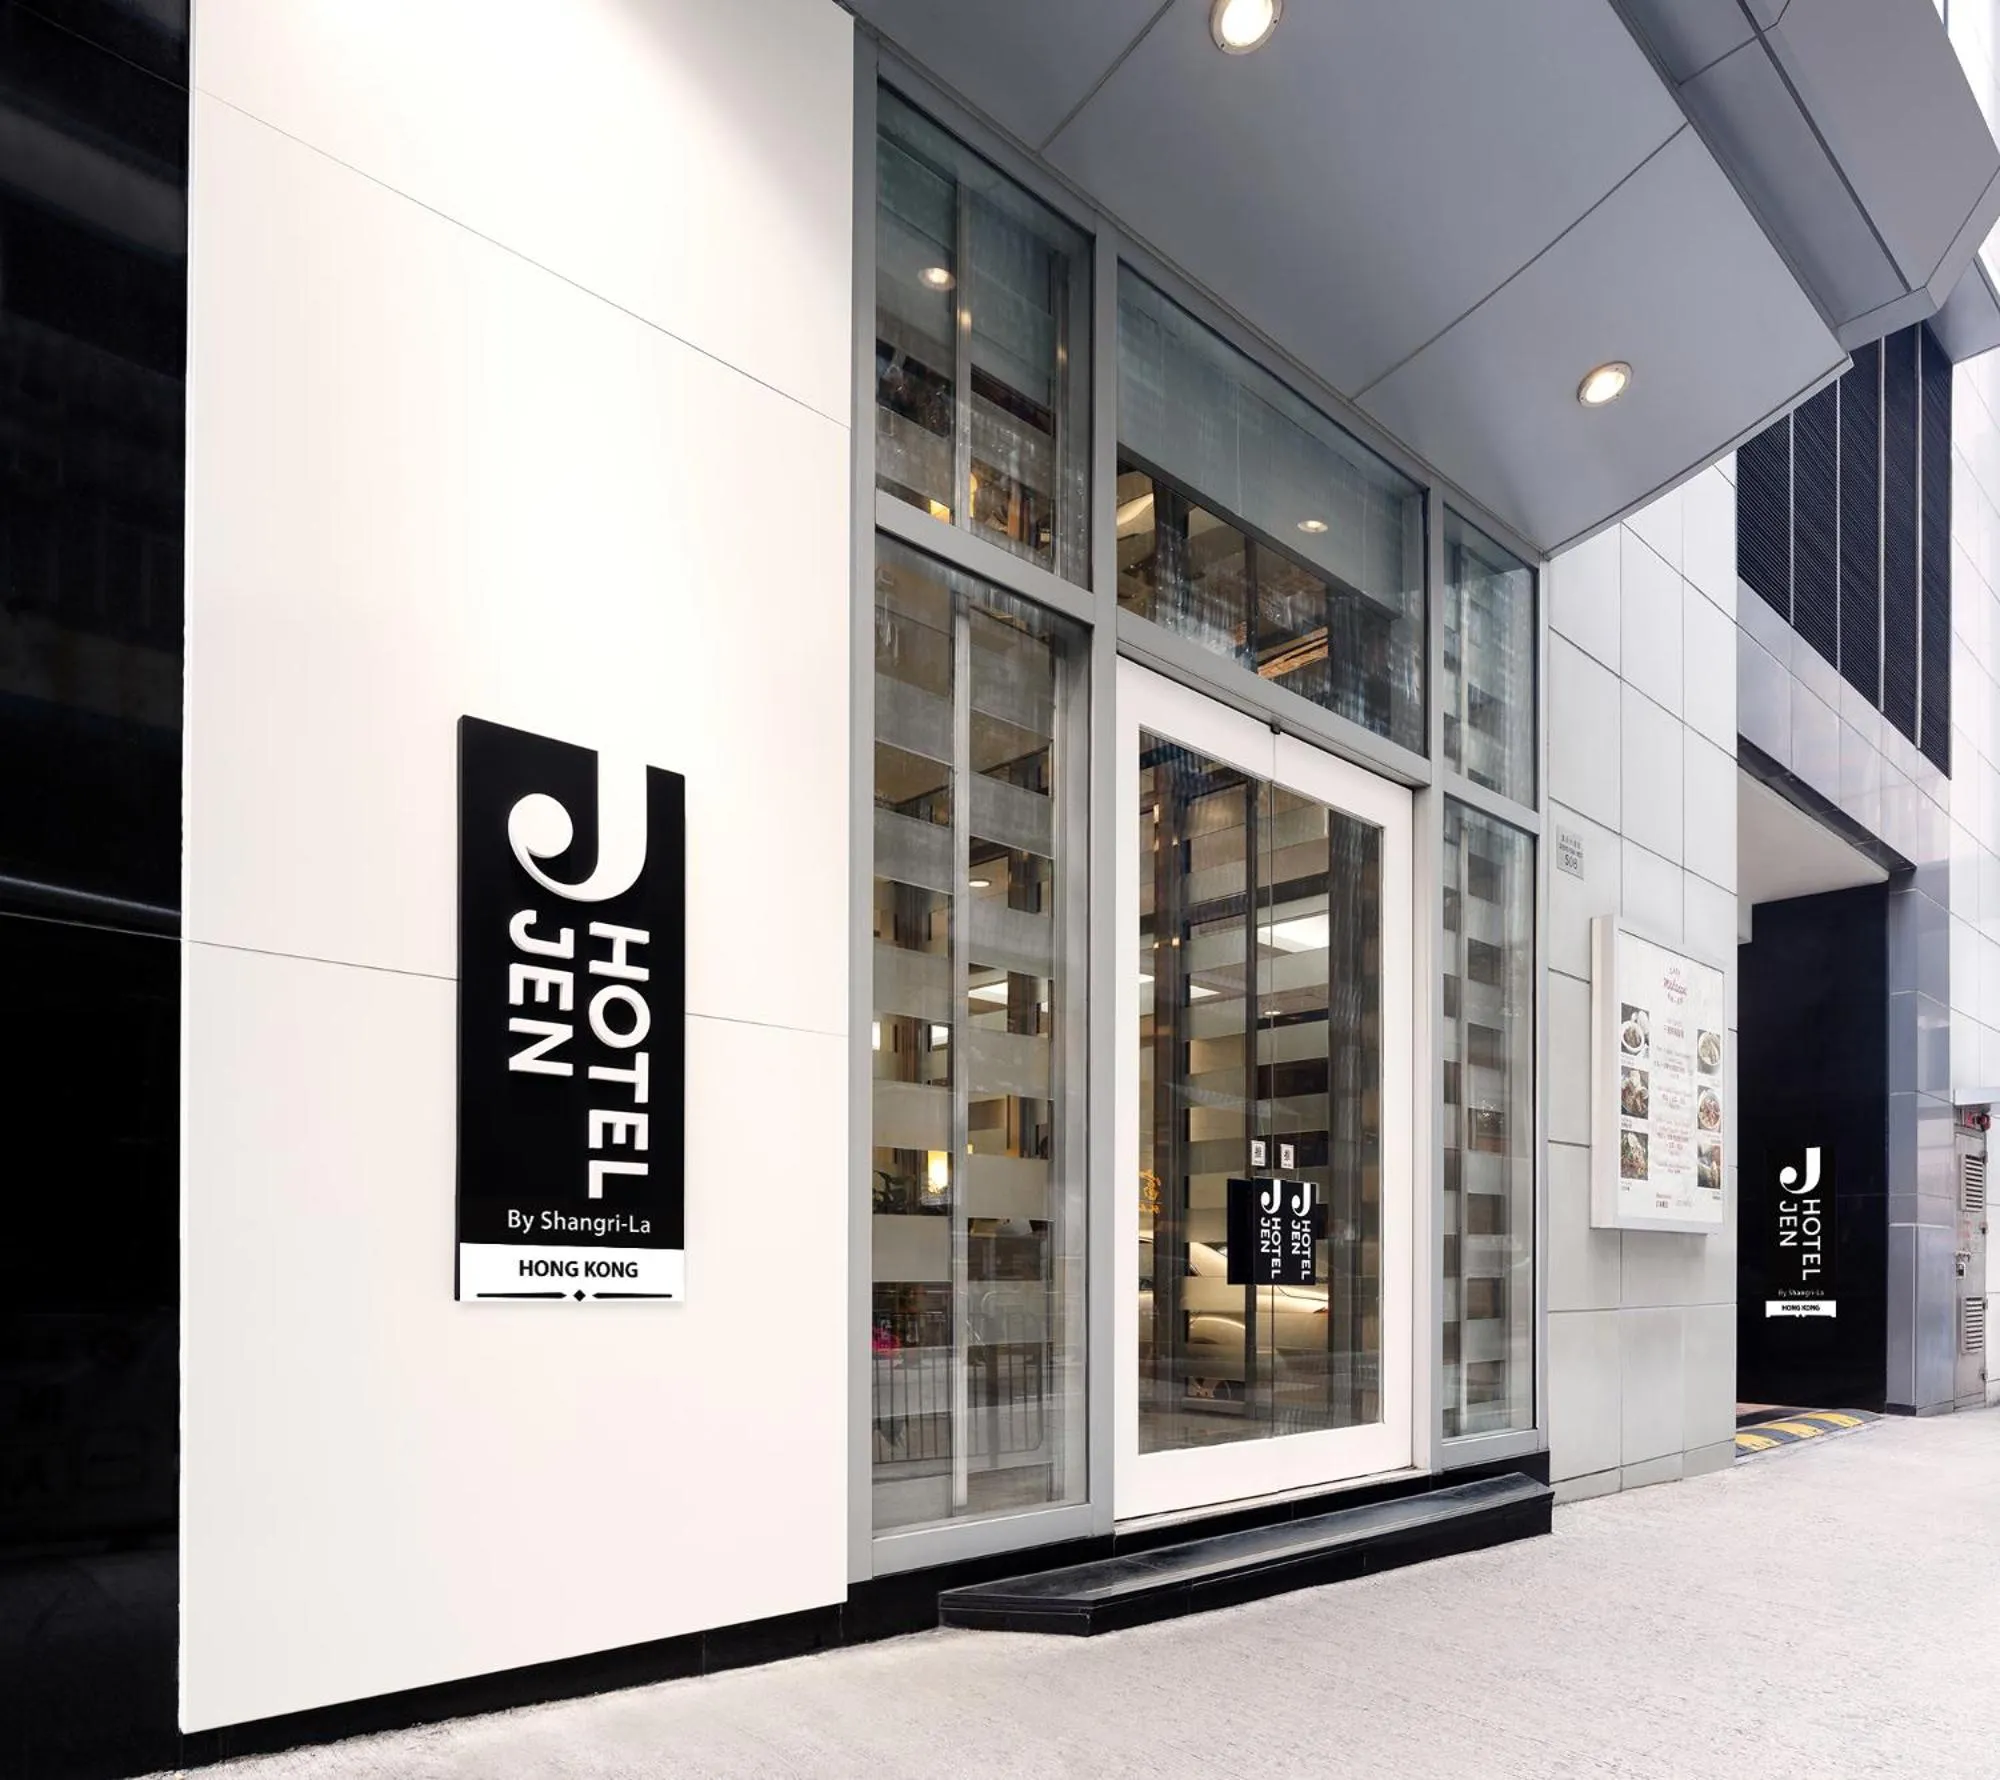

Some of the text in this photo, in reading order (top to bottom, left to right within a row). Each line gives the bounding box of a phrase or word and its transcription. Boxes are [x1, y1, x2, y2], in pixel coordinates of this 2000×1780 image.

[508, 909, 575, 1077] JEN
[588, 920, 651, 1199] HOTEL
[508, 1209, 651, 1237] By Shangri-La
[1260, 1216, 1271, 1253] JEN
[1291, 1219, 1301, 1255] JEN
[1779, 1200, 1798, 1247] JEN
[1802, 1199, 1821, 1281] HOTEL
[519, 1259, 639, 1279] HONG KONG
[1271, 1217, 1282, 1279] HOTEL
[1301, 1220, 1312, 1281] HOTEL
[1781, 1304, 1801, 1312] HONG
